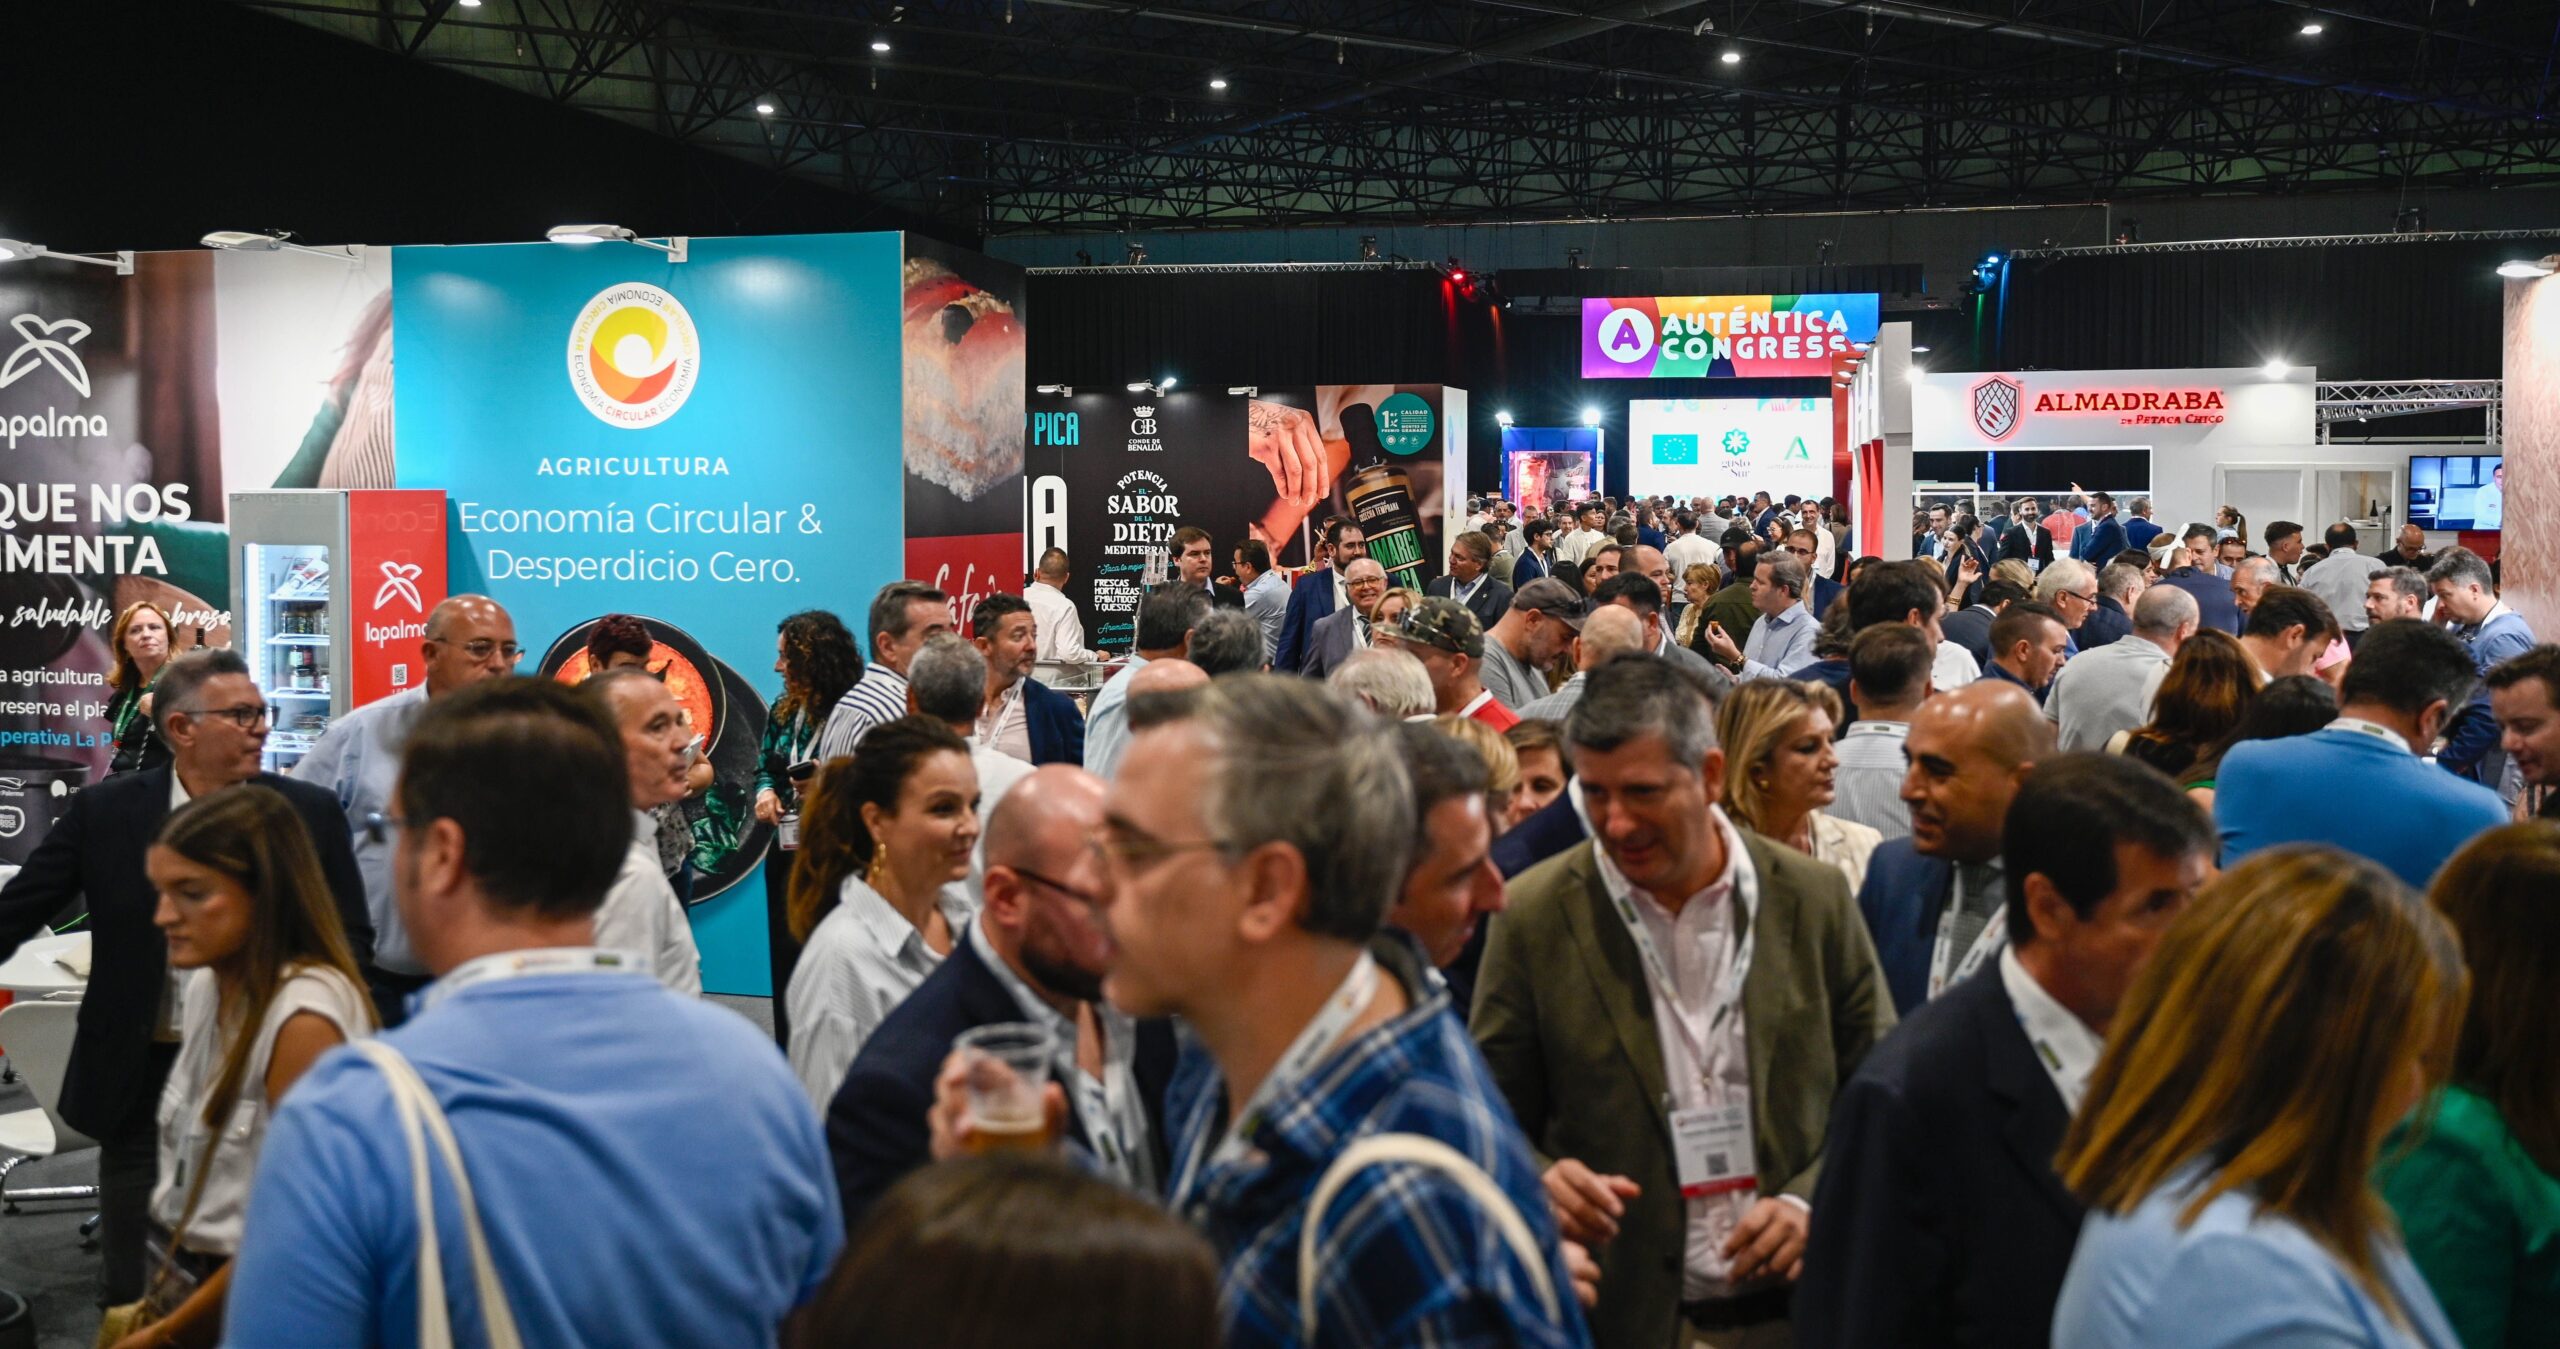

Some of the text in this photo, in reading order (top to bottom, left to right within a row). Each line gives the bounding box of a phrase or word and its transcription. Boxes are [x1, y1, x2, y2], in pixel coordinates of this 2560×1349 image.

[1662, 305, 1848, 336] AUTÉNTICA
[1661, 335, 1847, 360] CONGRESS
[2034, 391, 2224, 412] ALMADRABA
[605, 406, 658, 421] CIRCULAR
[1034, 412, 1079, 446] PICA
[537, 456, 730, 477] AGRICULTURA
[1116, 469, 1168, 493] POTENCIA
[91, 483, 192, 524] NOS
[1107, 494, 1181, 517] SABOR
[1376, 502, 1400, 516] TEMPRANA
[460, 502, 824, 535] Economía Circular &
[1113, 522, 1176, 543] DIETA
[488, 549, 801, 587] Desperdicio Cero.
[1094, 579, 1130, 587] FRESCAS
[1094, 595, 1138, 604] EMBUTIDOS
[1094, 603, 1135, 613] Y QUESOS.
[10, 596, 113, 631] saludable
[12, 666, 103, 687] agricultura
[65, 700, 80, 717] el
[1, 728, 71, 747] perativa
[76, 731, 96, 747] La
